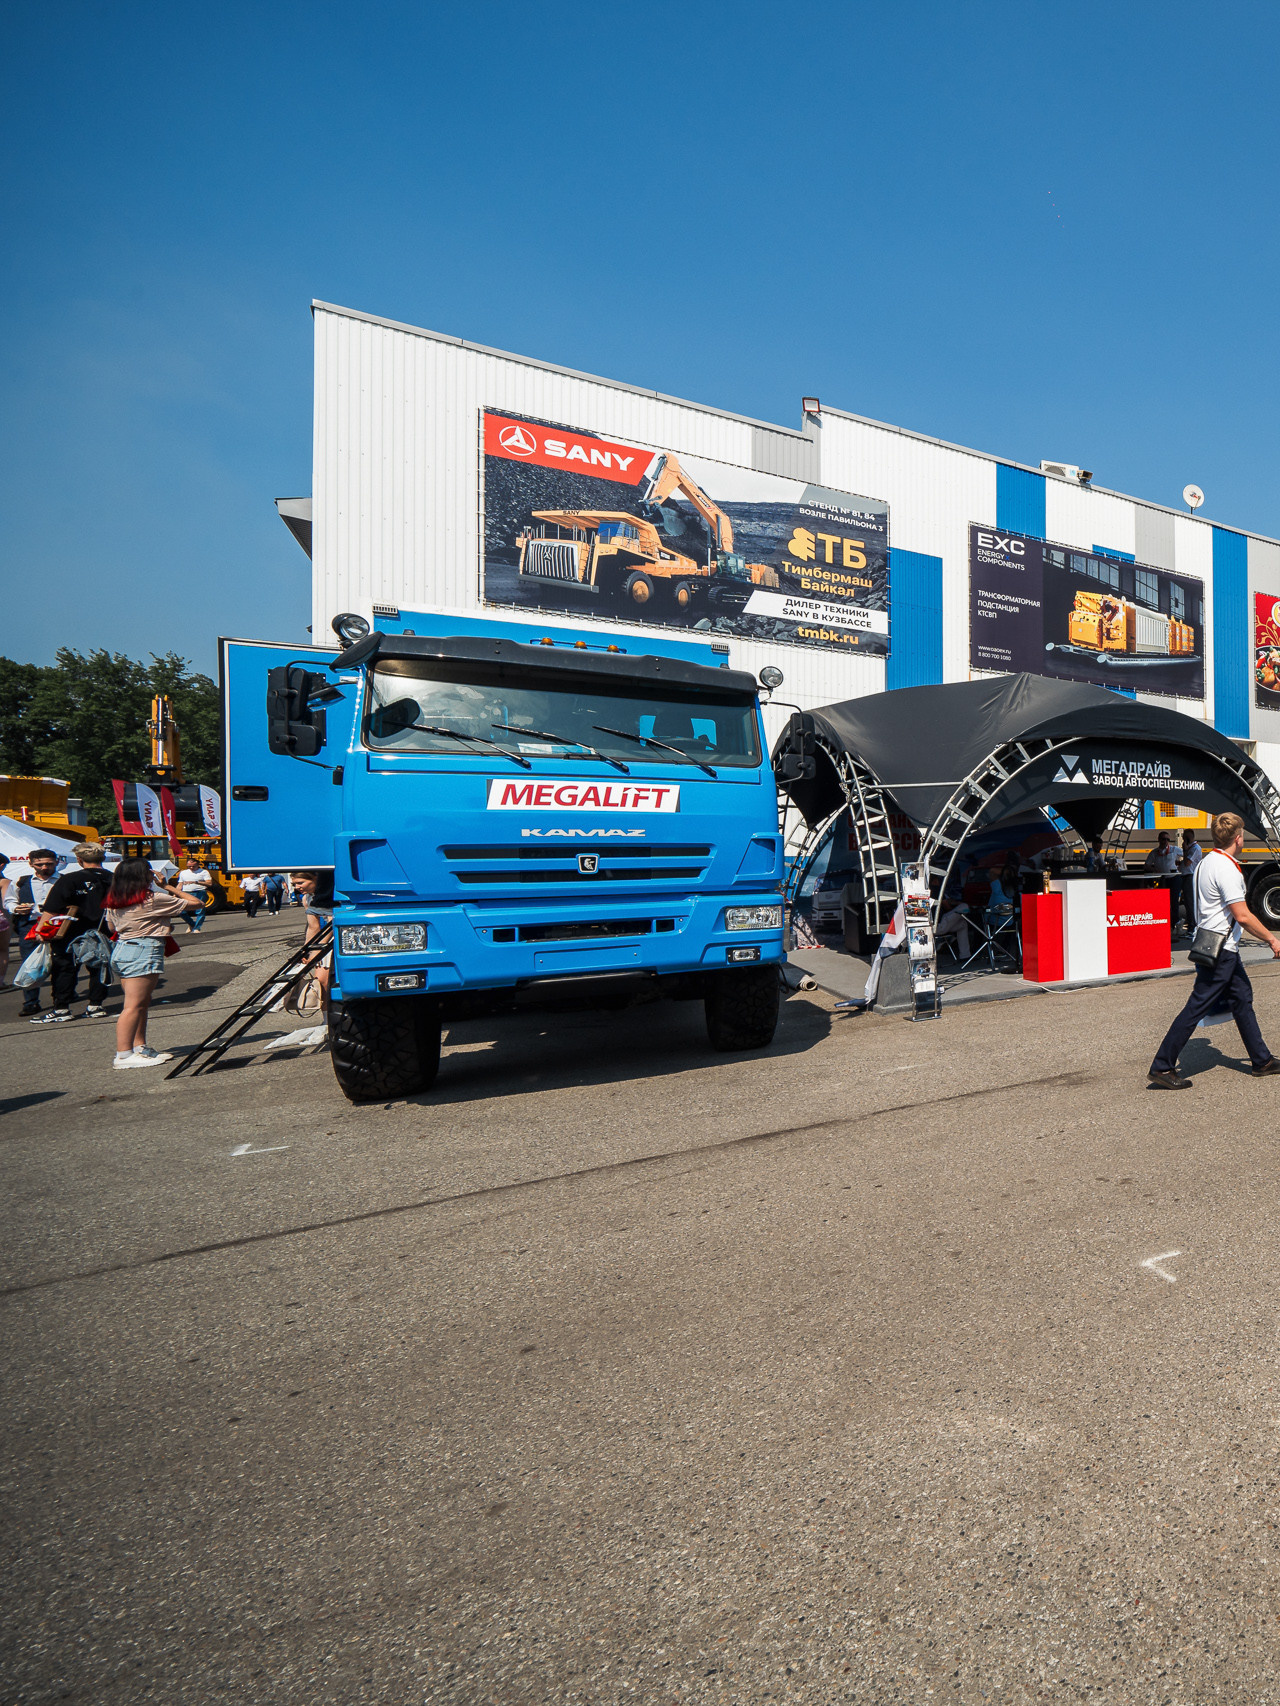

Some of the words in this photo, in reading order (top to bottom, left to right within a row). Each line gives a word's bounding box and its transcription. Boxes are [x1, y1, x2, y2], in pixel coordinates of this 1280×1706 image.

[544, 439, 635, 472] SANY
[799, 508, 827, 519] ВОЗЛЕ
[828, 515, 877, 531] ПАВИЛЬОНА
[808, 500, 839, 513] СТЕНД
[851, 510, 863, 519] 81,
[864, 513, 876, 521] 84
[817, 532, 867, 570] ТБ
[977, 532, 1025, 556] EXC
[977, 549, 1005, 560] ENERGY
[977, 556, 1025, 571] COMPONENTS
[781, 561, 873, 588] Тимбермаш
[801, 577, 855, 598] Байкал
[785, 598, 821, 610] ДИЛЕР
[823, 604, 869, 619] ТЕХНИКИ
[977, 590, 1041, 608] ТРАНСФОРМАТОРНАЯ
[977, 600, 1020, 614] ПОДСТАНЦИЯ
[782, 608, 810, 618] SANY
[812, 612, 819, 620] В
[821, 614, 872, 629] КУЗБАССЕ
[977, 610, 997, 619] КТСВП
[797, 626, 859, 645] tmbk.ru
[1091, 759, 1172, 778] МЕГАДРАЙВ
[1092, 775, 1124, 788] ЗАВОД
[1125, 777, 1205, 791] АВТОСПЕЦТЕХНИКИ
[521, 828, 646, 838] KAMAZ
